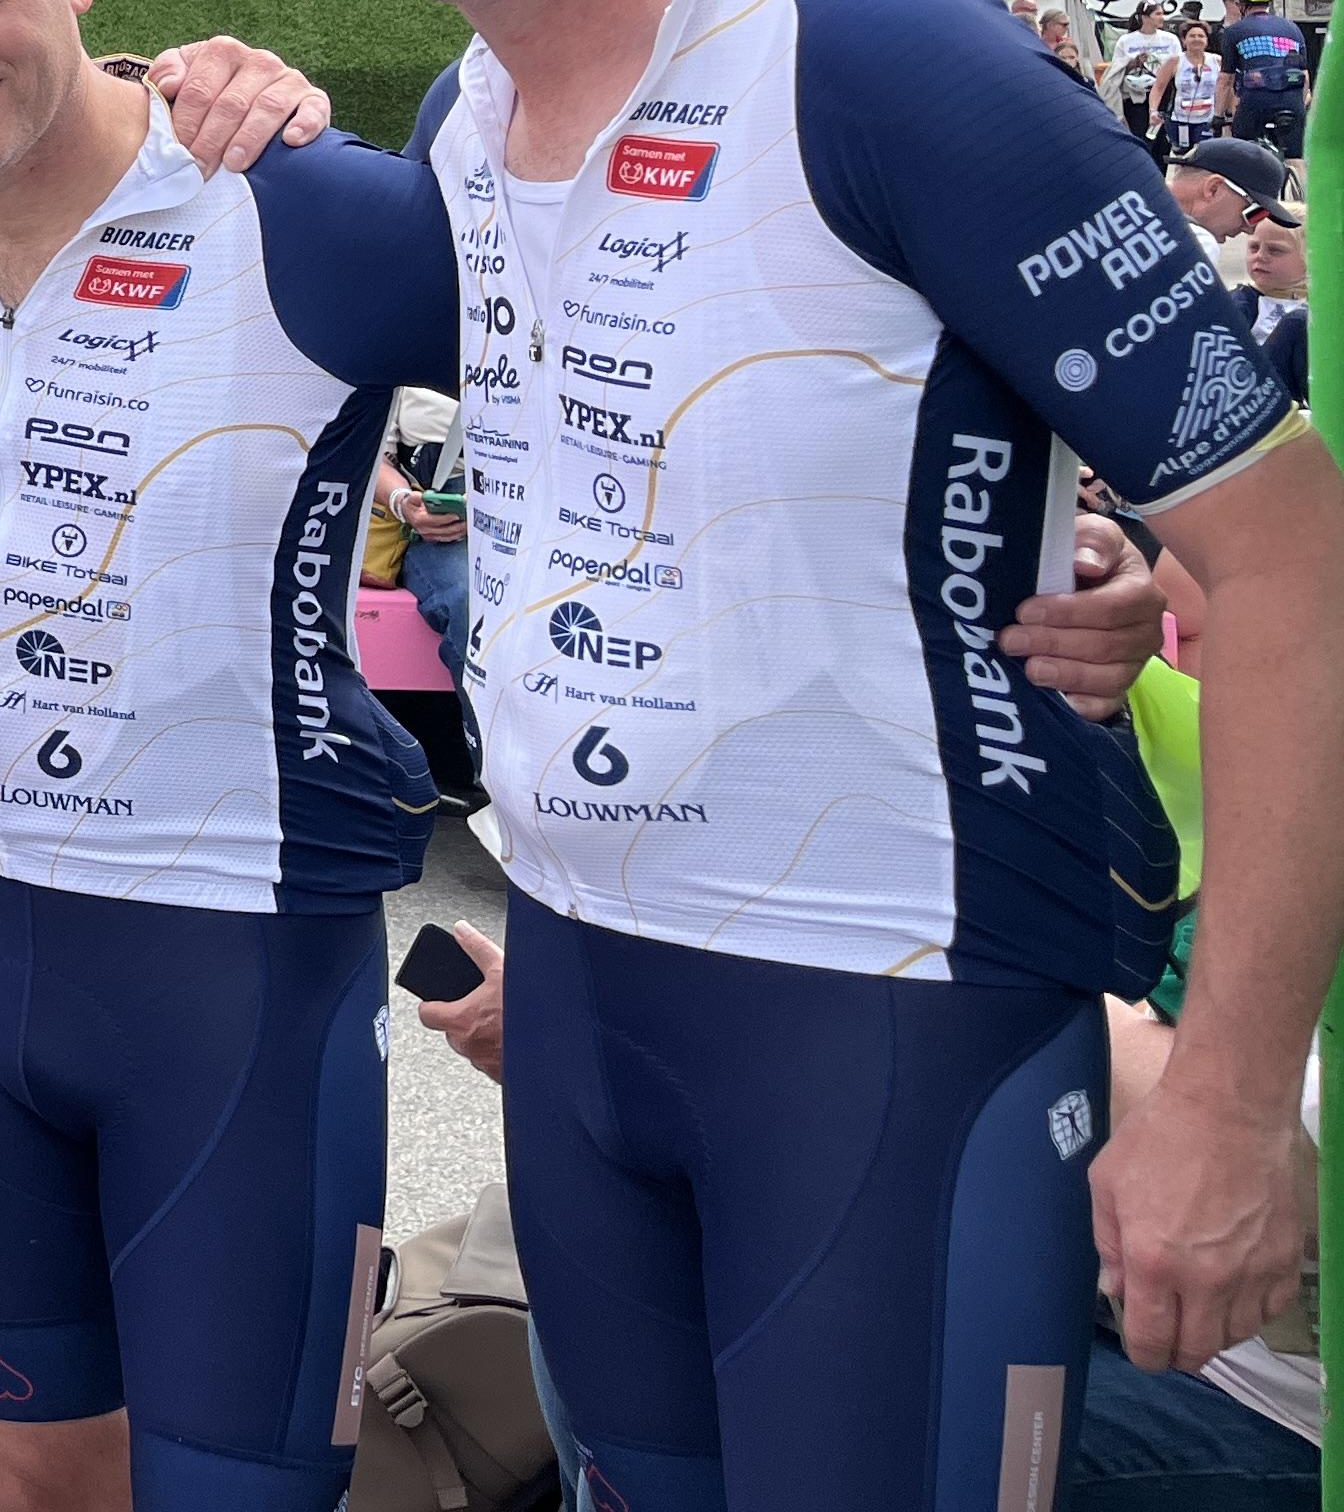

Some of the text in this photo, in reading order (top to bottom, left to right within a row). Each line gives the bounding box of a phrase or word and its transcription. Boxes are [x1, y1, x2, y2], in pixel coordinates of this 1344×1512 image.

[629, 102, 728, 125] BIORACER
[623, 144, 685, 161] Samen met
[643, 167, 694, 188] KWF
[100, 226, 195, 252] BIORACER
[1018, 190, 1156, 297] POWER
[1101, 219, 1178, 290] ADE
[95, 264, 155, 279] Samen met
[589, 272, 654, 291] 24/7 mobiliteit
[109, 281, 165, 298] KWF
[580, 305, 676, 336] funraisin.co
[1105, 262, 1215, 358] COOSTO
[50, 355, 127, 375] 24/7 mobiliteit
[46, 382, 150, 413] funraisin.co
[559, 393, 666, 450] YPEX.nl
[1149, 436, 1211, 487] Alpe
[20, 461, 137, 506] YPEX.nl
[558, 507, 674, 547] BIKE Totaal
[5, 554, 128, 586] BIKE Totaal
[548, 548, 651, 586] papendal
[3, 587, 104, 621] papendal
[291, 481, 352, 764] Rabobank
[576, 631, 662, 671] NEP
[41, 655, 113, 685] NEP
[33, 699, 136, 719] Hart van Holland
[565, 684, 696, 712] Hart van Holland
[37, 730, 82, 779] 6
[572, 725, 629, 787] 6
[0, 785, 134, 816] LOUWMAN
[532, 792, 708, 824] LOUWMAN
